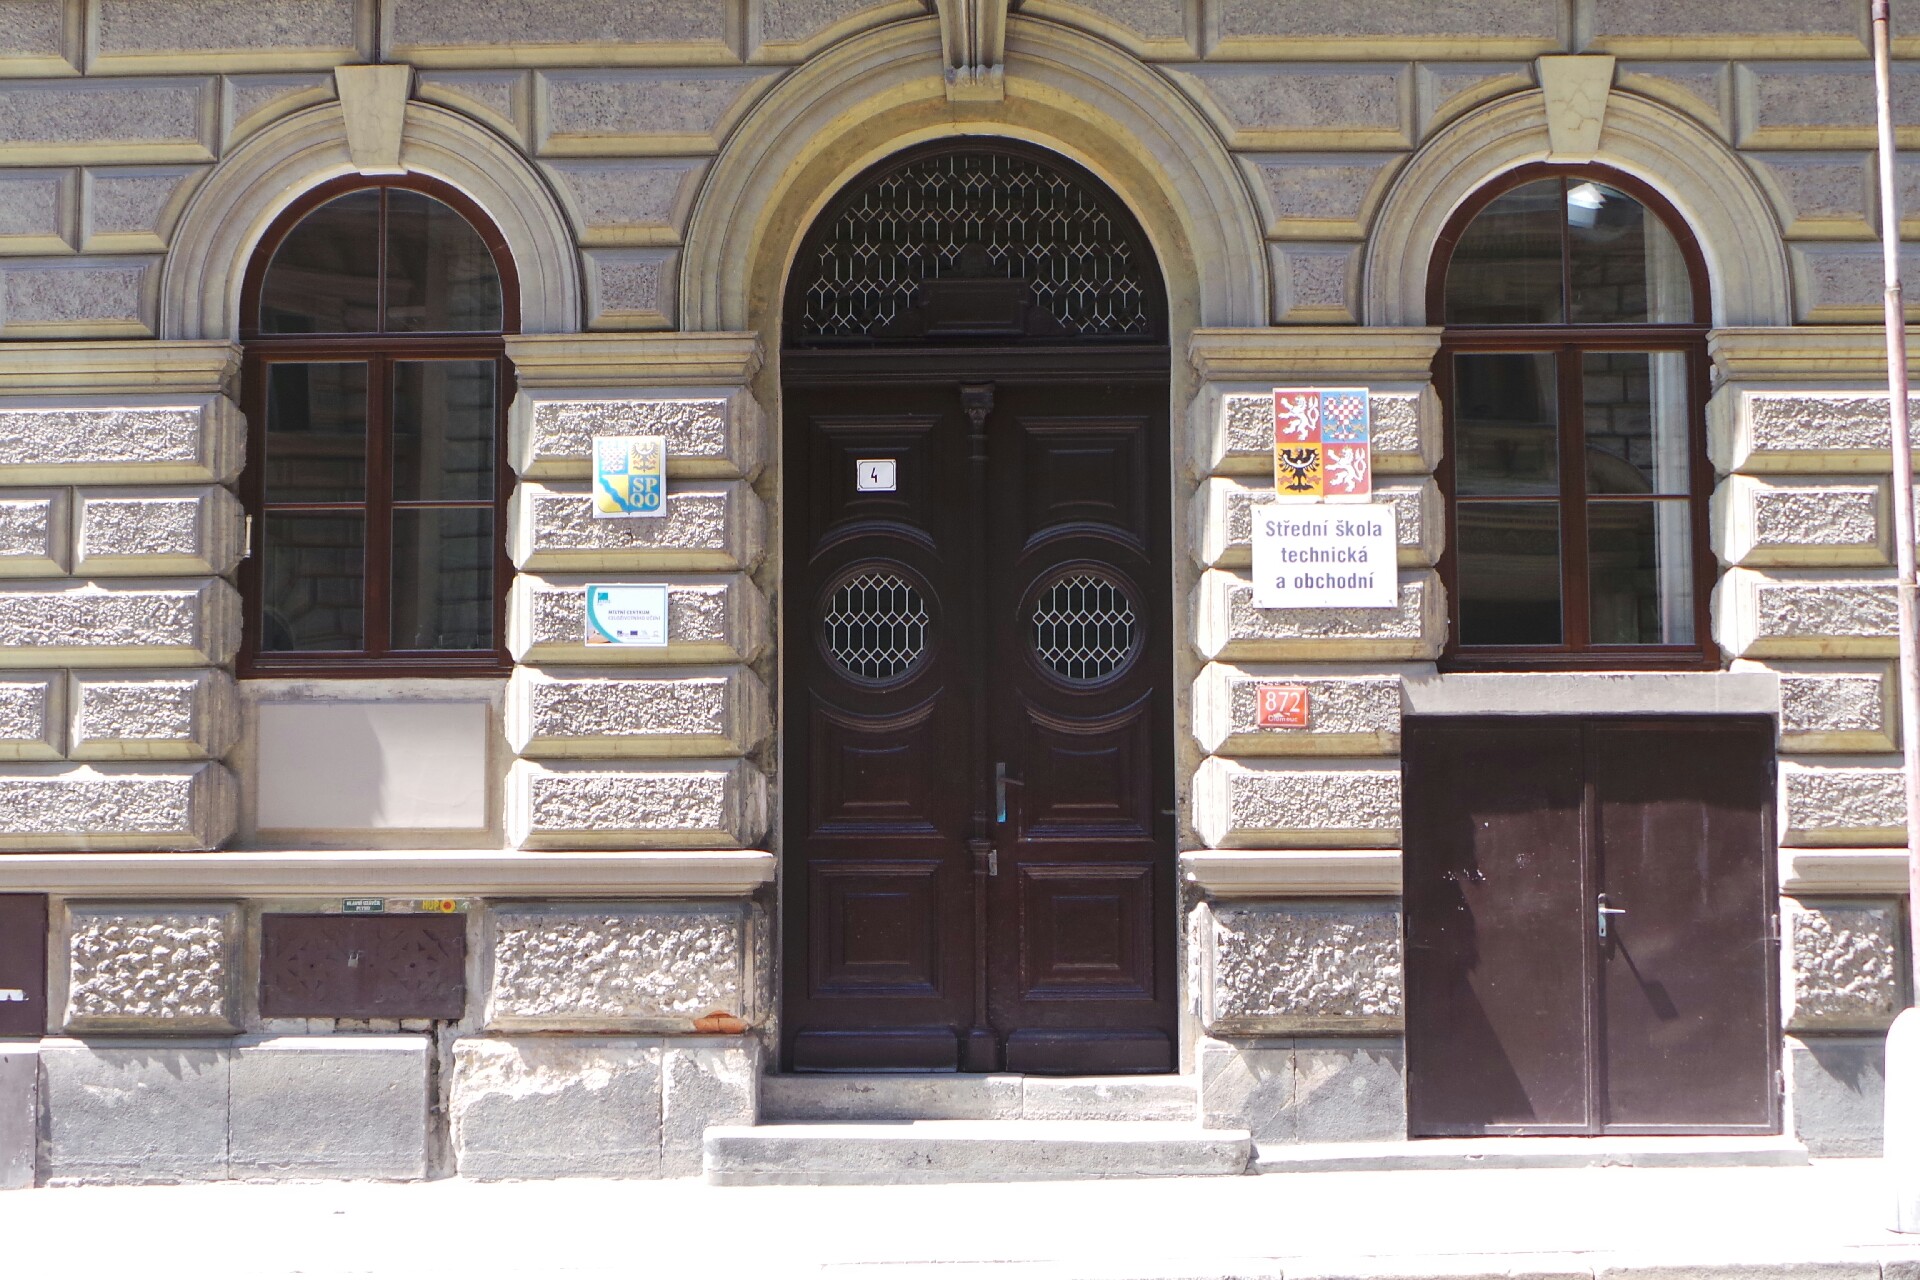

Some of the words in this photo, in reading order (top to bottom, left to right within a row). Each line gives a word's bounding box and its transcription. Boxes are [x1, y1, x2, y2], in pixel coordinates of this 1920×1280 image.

[871, 467, 878, 484] 4
[633, 477, 658, 492] SP
[629, 493, 659, 508] QO
[1265, 519, 1328, 537] Střední
[1335, 519, 1382, 537] škola
[1281, 545, 1368, 563] technická
[1276, 576, 1286, 589] a
[1294, 572, 1374, 589] obchodní
[1265, 691, 1301, 712] 872
[423, 900, 441, 911] HUP
